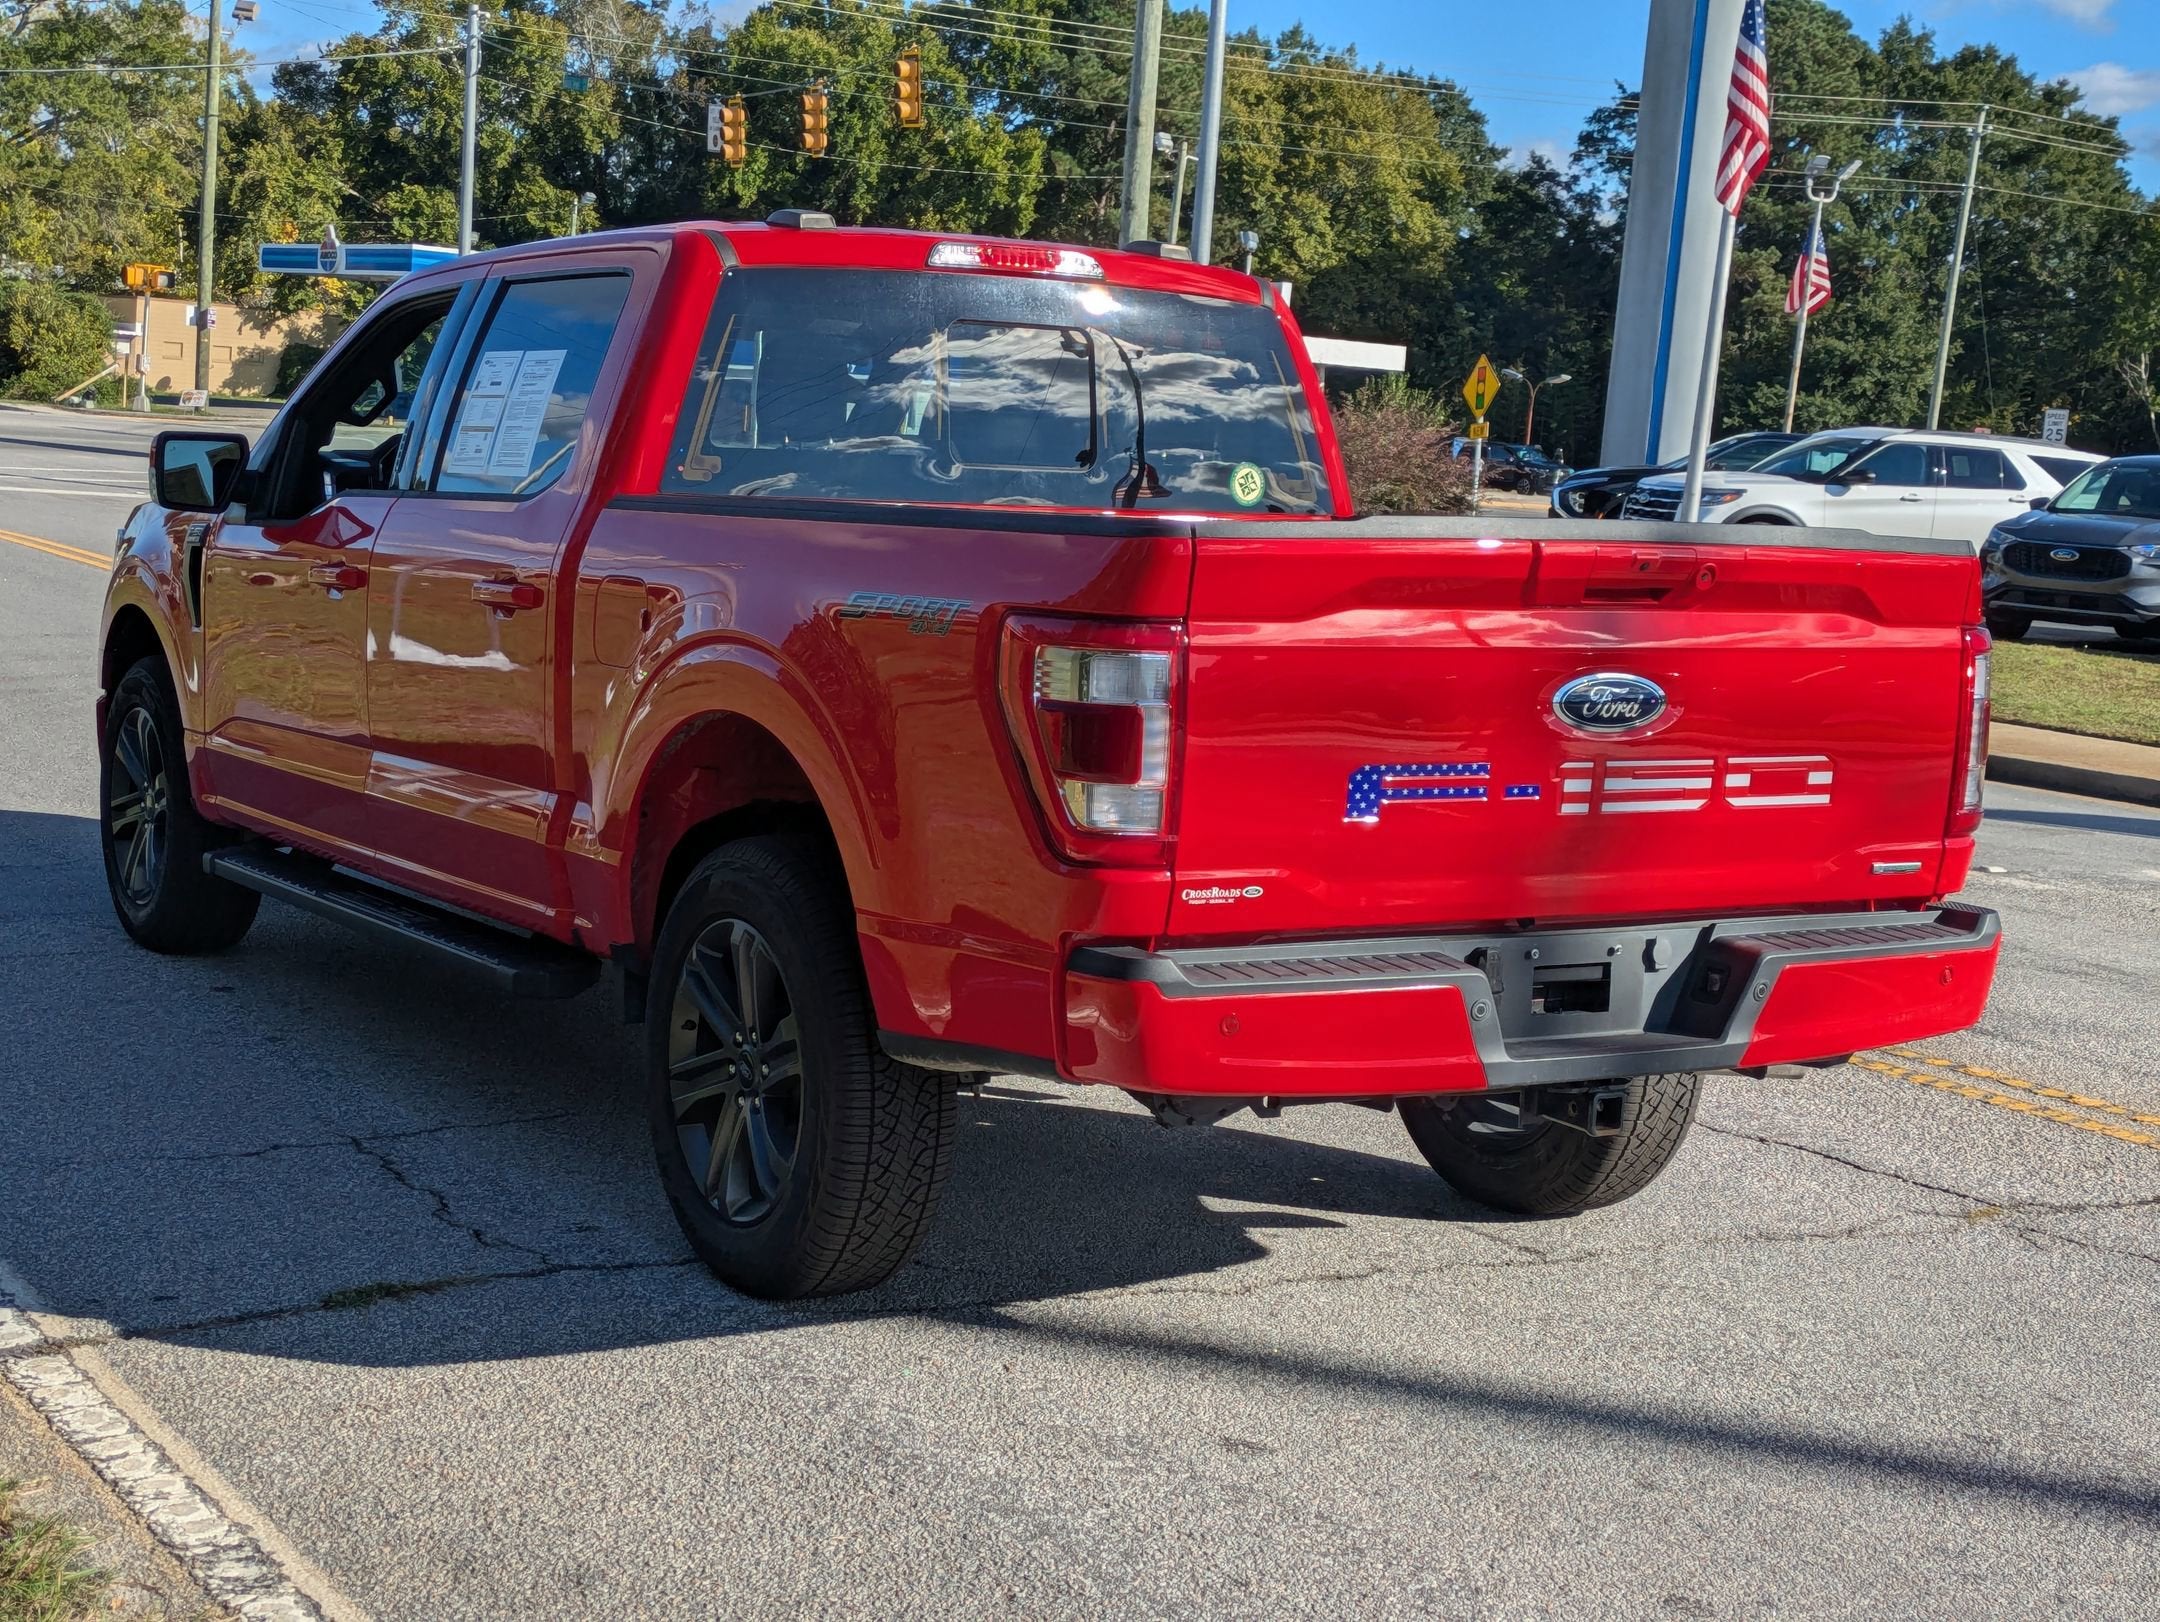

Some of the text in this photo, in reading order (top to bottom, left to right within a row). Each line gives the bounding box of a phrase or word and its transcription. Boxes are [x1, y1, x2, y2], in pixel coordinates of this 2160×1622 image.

[2045, 428, 2064, 442] 25
[839, 591, 973, 621] SPORT
[1582, 686, 1642, 719] Ford
[1342, 755, 1834, 822] F-150
